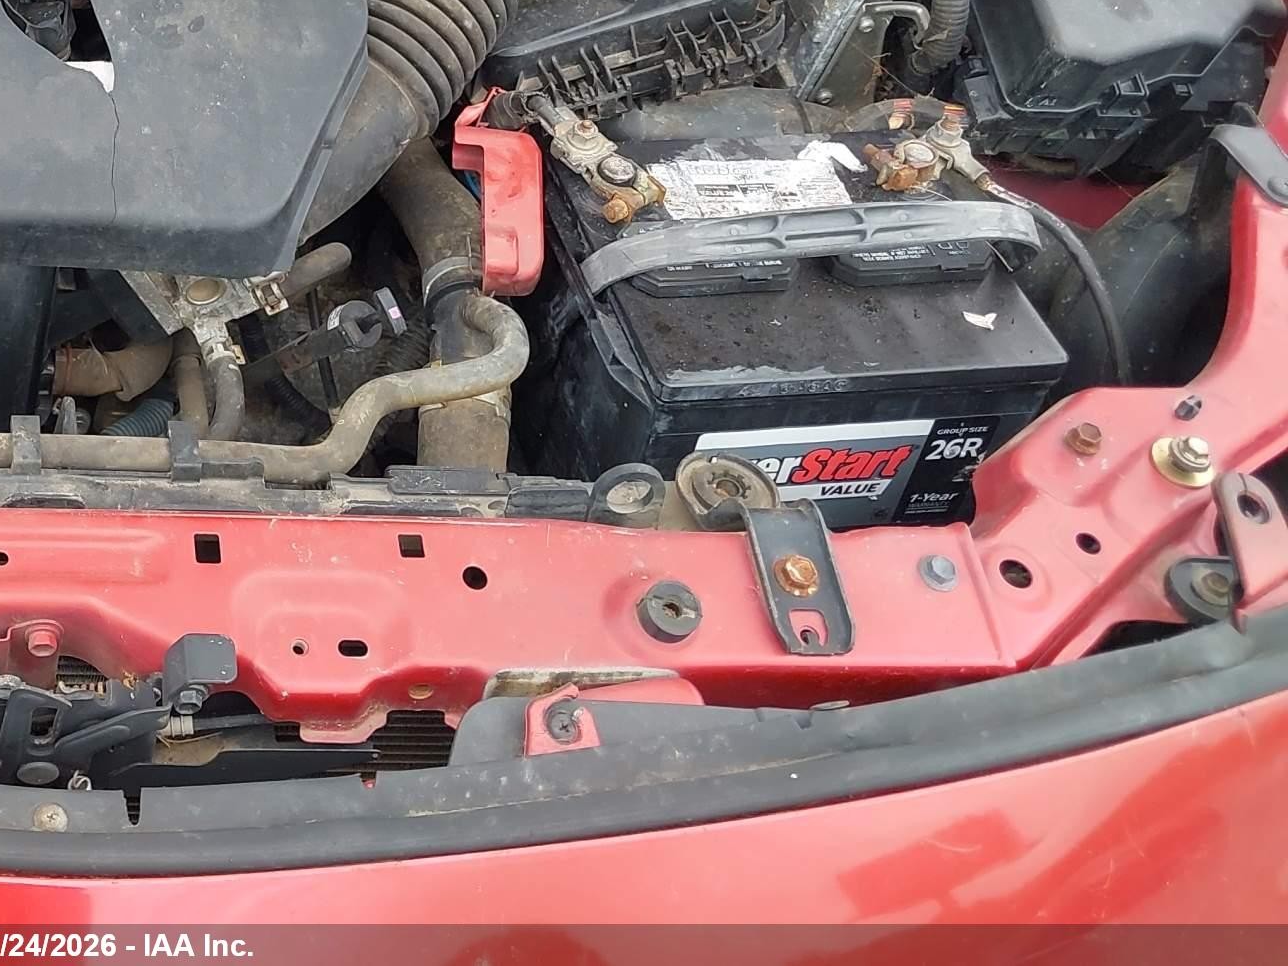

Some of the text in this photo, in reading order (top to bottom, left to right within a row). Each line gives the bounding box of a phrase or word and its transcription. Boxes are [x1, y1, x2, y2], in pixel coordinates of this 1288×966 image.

[937, 427, 968, 435] GROUP
[924, 437, 983, 460] 26R
[820, 482, 881, 497] VALUE
[910, 492, 959, 503] 1-Year
